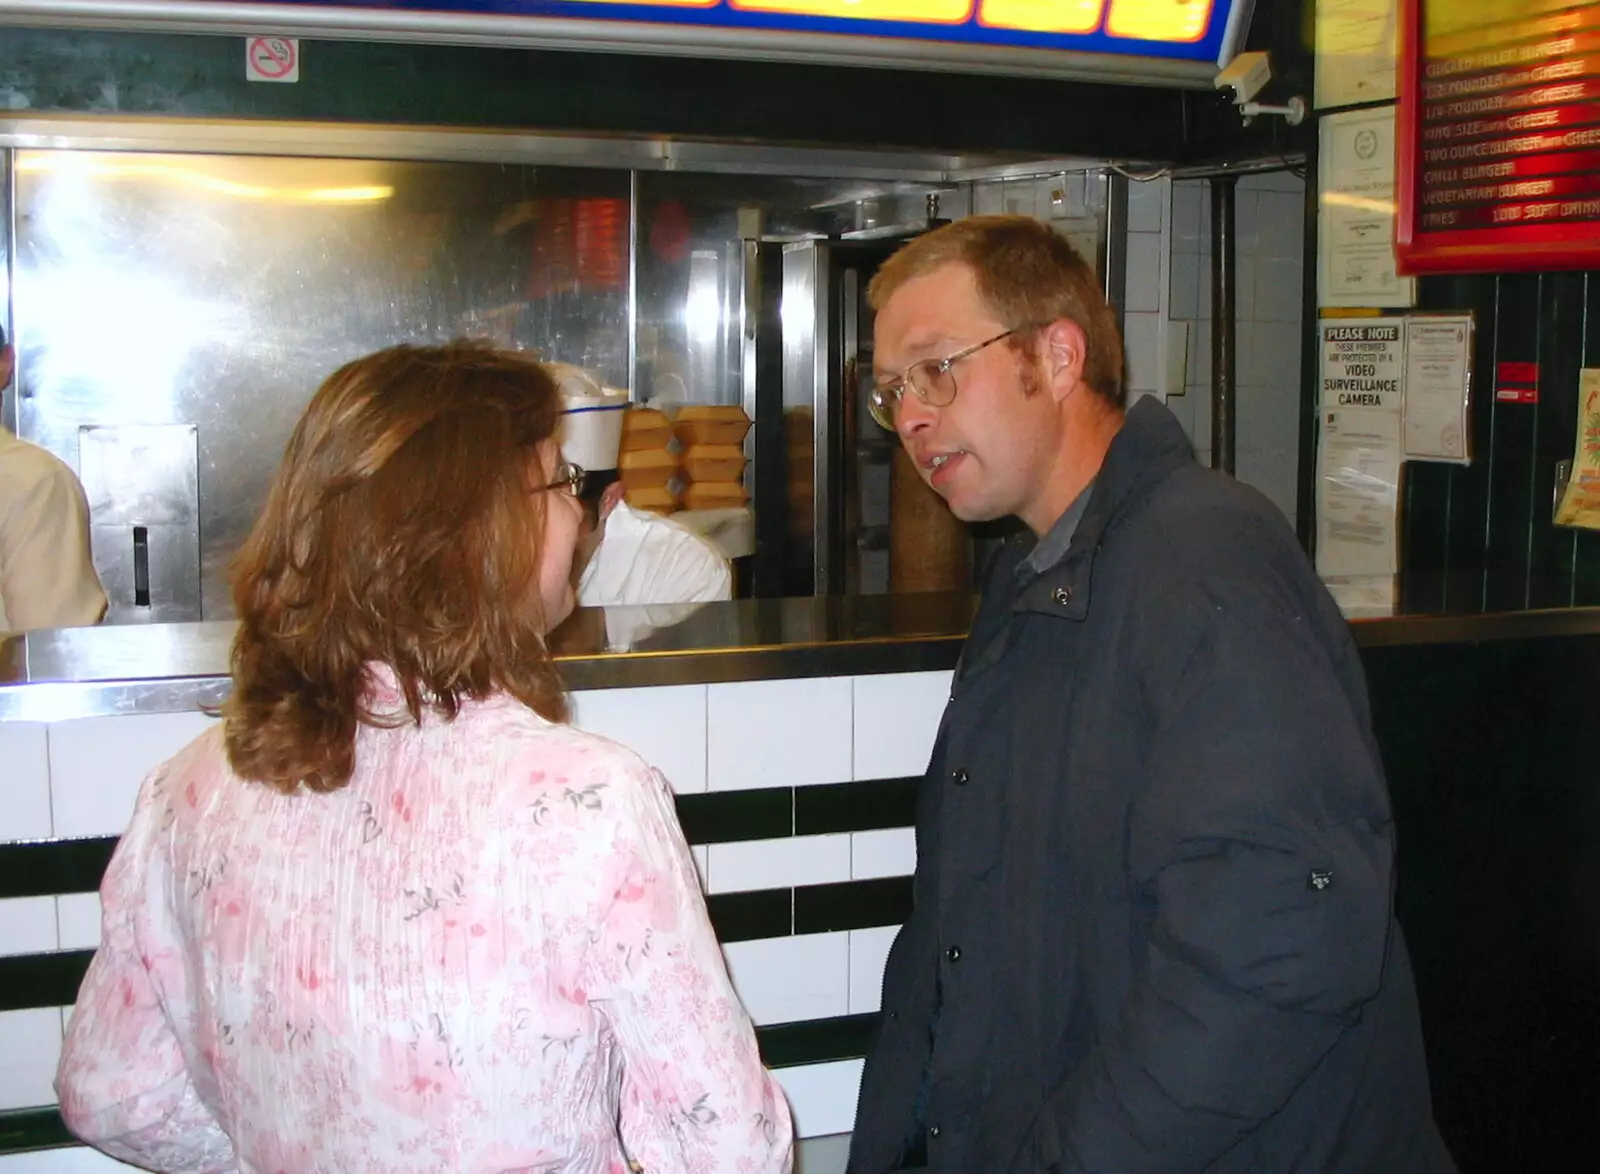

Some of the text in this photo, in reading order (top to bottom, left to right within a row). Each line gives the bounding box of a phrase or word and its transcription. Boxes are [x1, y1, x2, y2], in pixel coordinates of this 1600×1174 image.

[1449, 73, 1504, 94] POUNDER
[1530, 60, 1585, 81] CHEESE
[1449, 95, 1504, 115] POUNDER
[1530, 83, 1586, 105] CHEESE
[1455, 121, 1482, 136] SIZE
[1506, 110, 1560, 130] CHEESE
[1424, 148, 1448, 163] TWO
[1449, 143, 1489, 160] OUNCE
[1490, 135, 1544, 155] BURGER
[1424, 161, 1515, 184] CHILLI BURGER
[1422, 180, 1553, 205] VEGETARIAN BURGER
[1327, 327, 1395, 340] PLEASE NOTE
[1344, 364, 1376, 376] VIDEO
[1324, 379, 1397, 392] SURVEILLANCE
[1338, 394, 1381, 406] CAMERA
